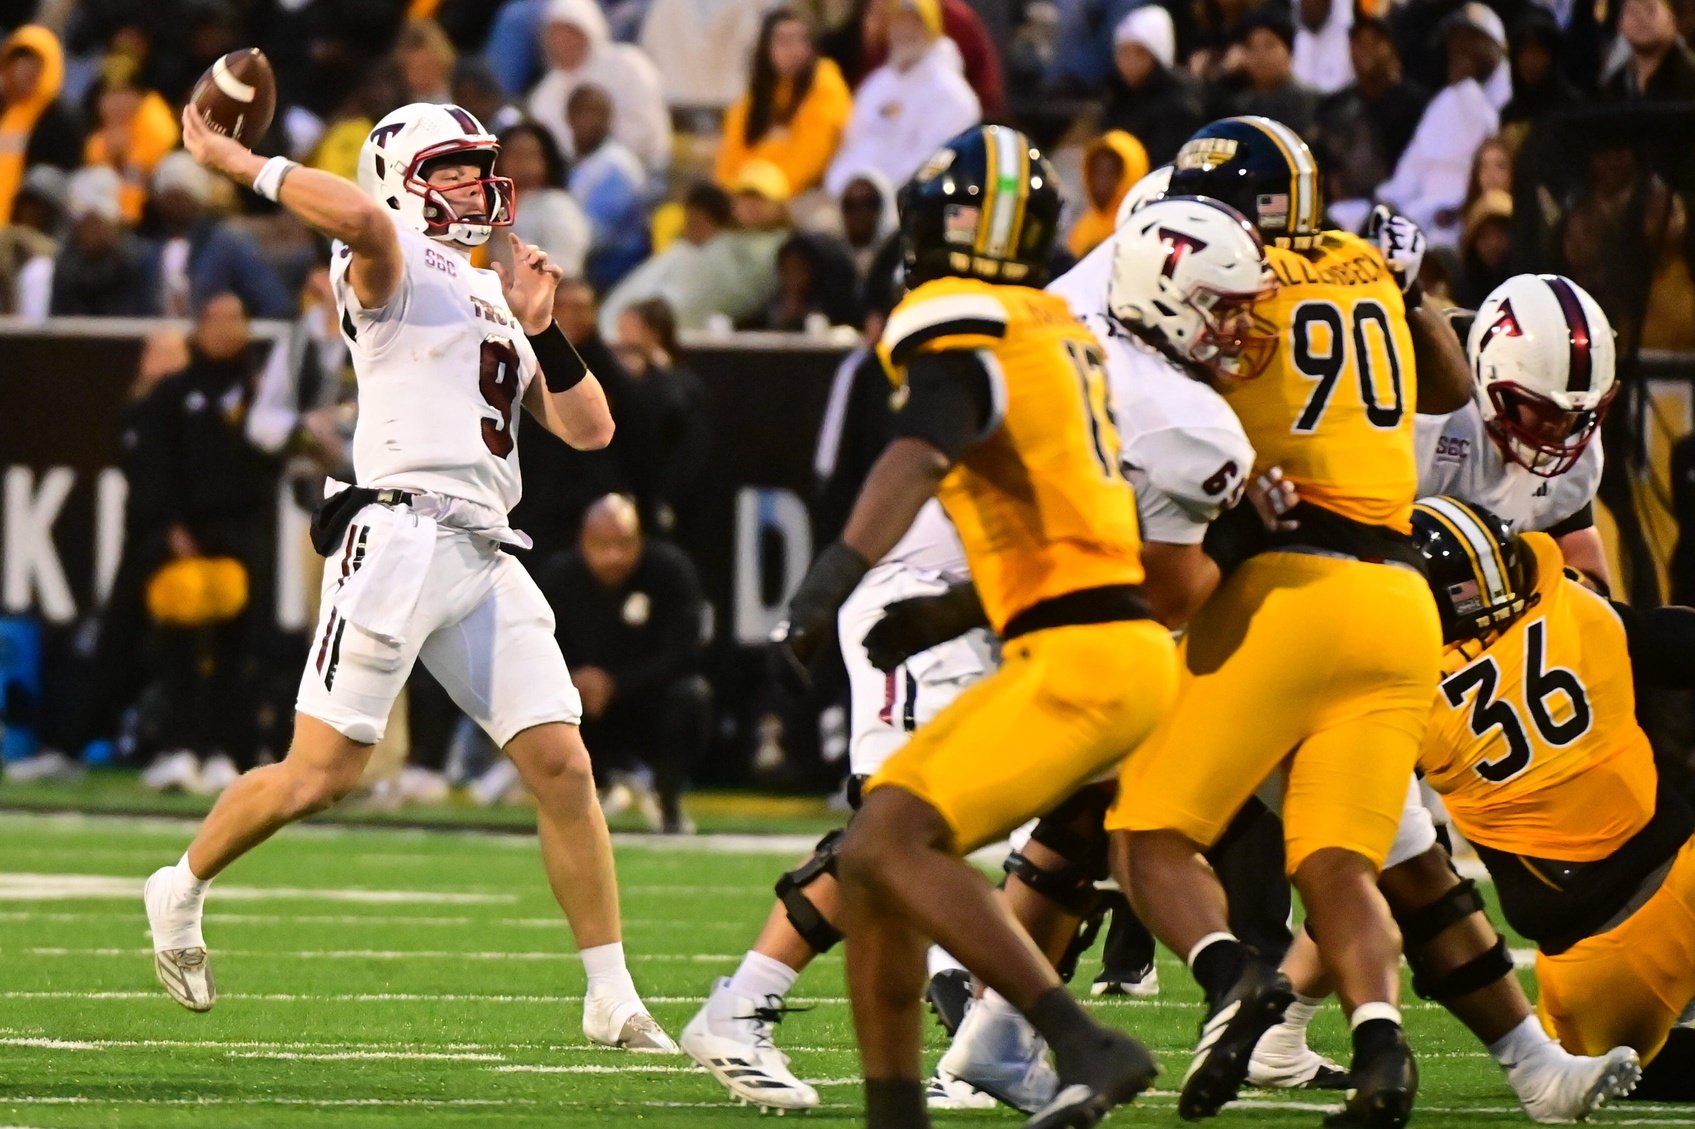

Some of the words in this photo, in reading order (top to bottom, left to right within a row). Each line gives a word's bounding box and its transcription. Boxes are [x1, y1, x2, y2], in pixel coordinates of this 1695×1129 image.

[1158, 227, 1209, 281] T
[478, 332, 521, 461] 9
[1290, 300, 1403, 435] 90
[1437, 614, 1594, 785] 36
